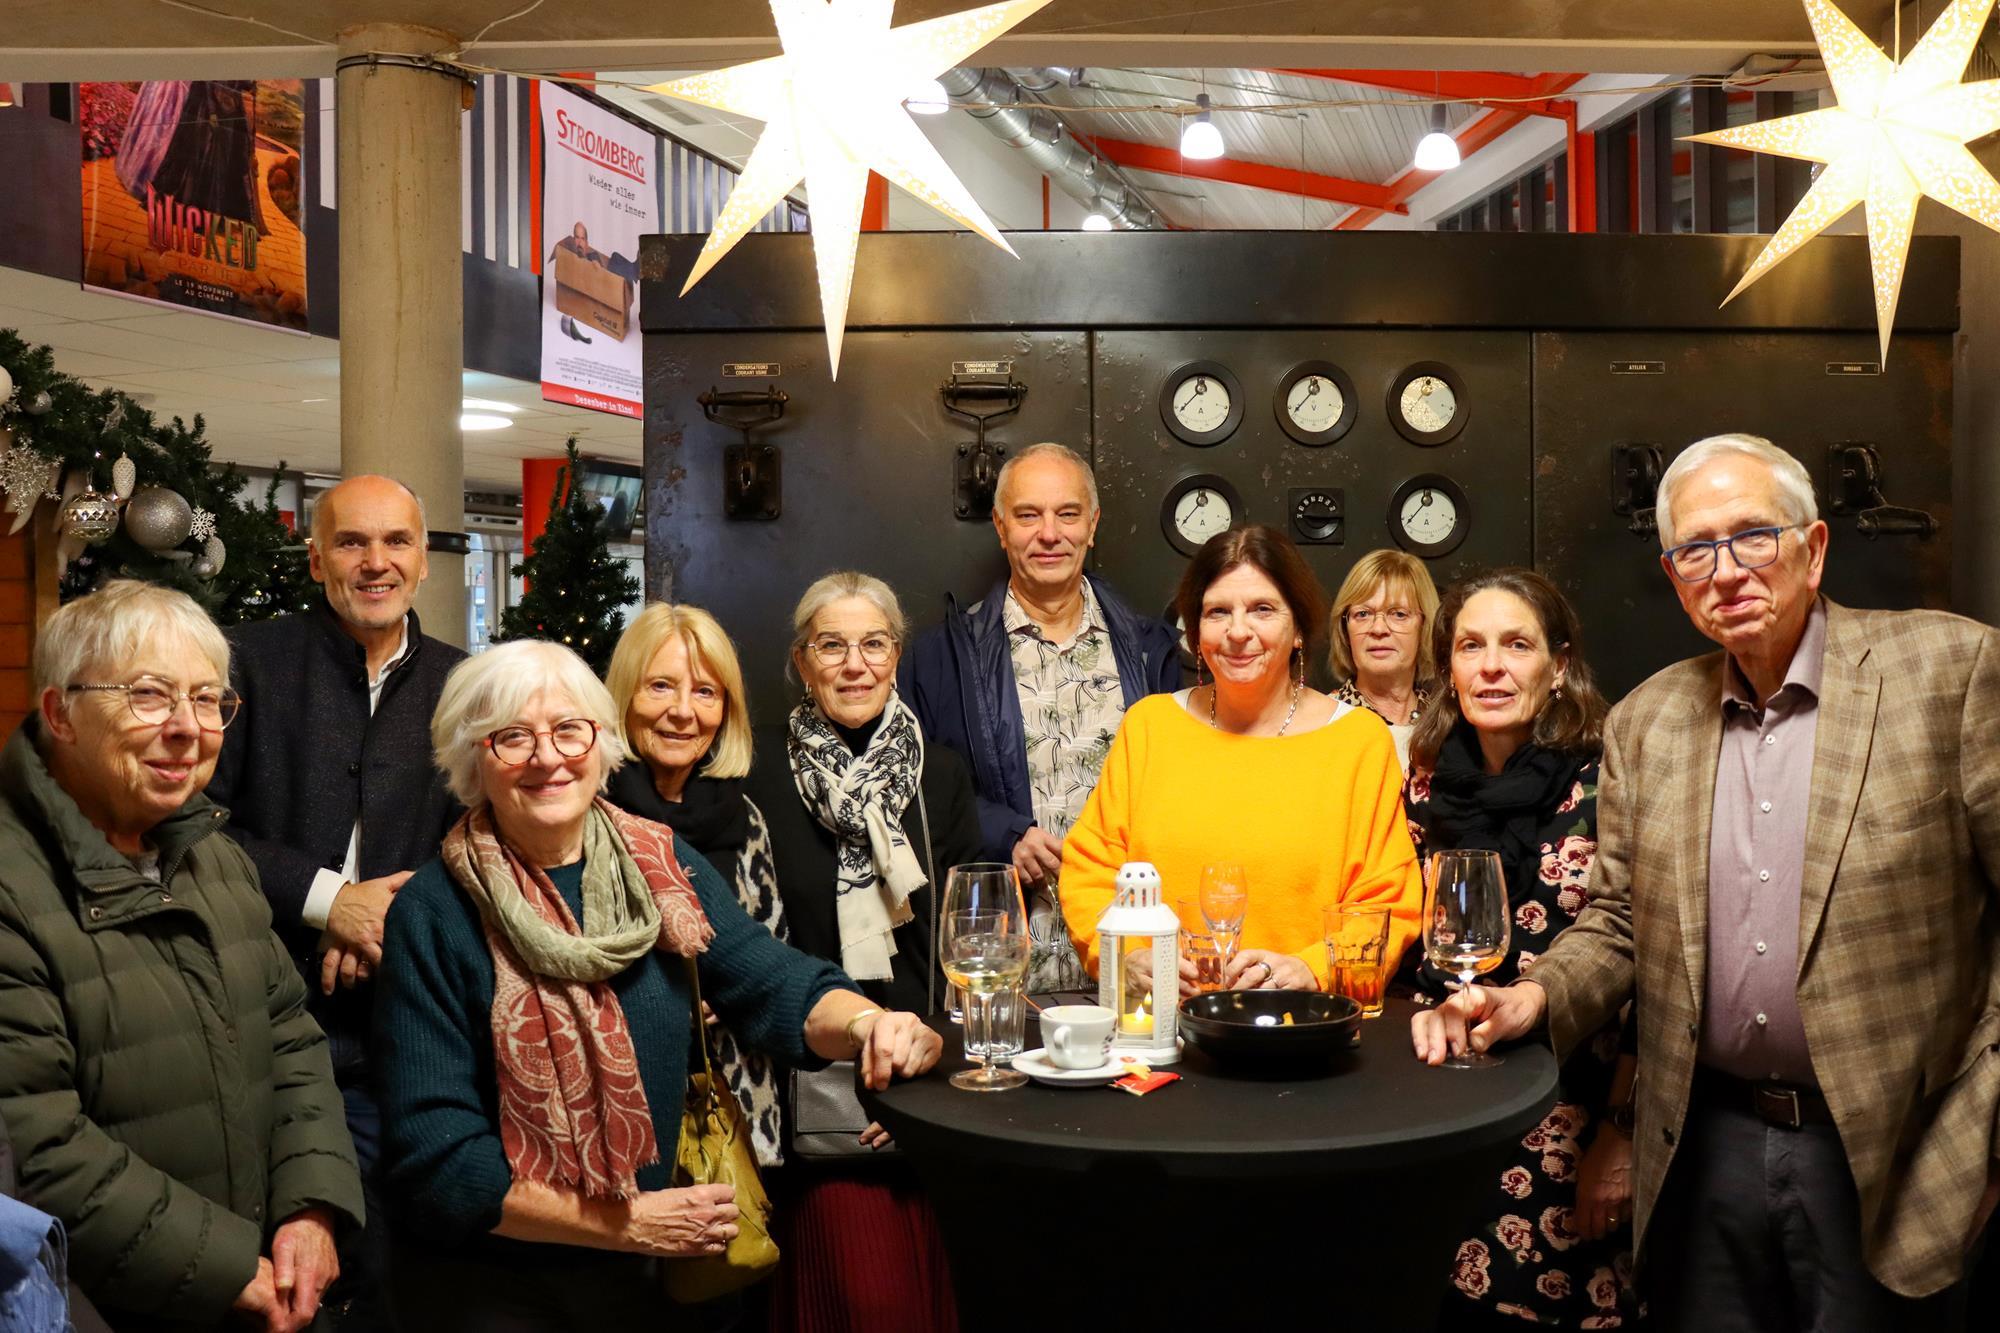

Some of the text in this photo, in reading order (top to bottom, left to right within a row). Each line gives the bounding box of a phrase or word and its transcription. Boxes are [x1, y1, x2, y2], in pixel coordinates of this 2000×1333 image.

[556, 108, 645, 178] STROMBERG
[588, 174, 636, 200] Wieder alles
[610, 198, 647, 219] wie immer
[145, 181, 257, 272] WICKED
[174, 279, 183, 287] LE
[197, 284, 234, 298] NOVEMBRE
[185, 288, 195, 296] AU
